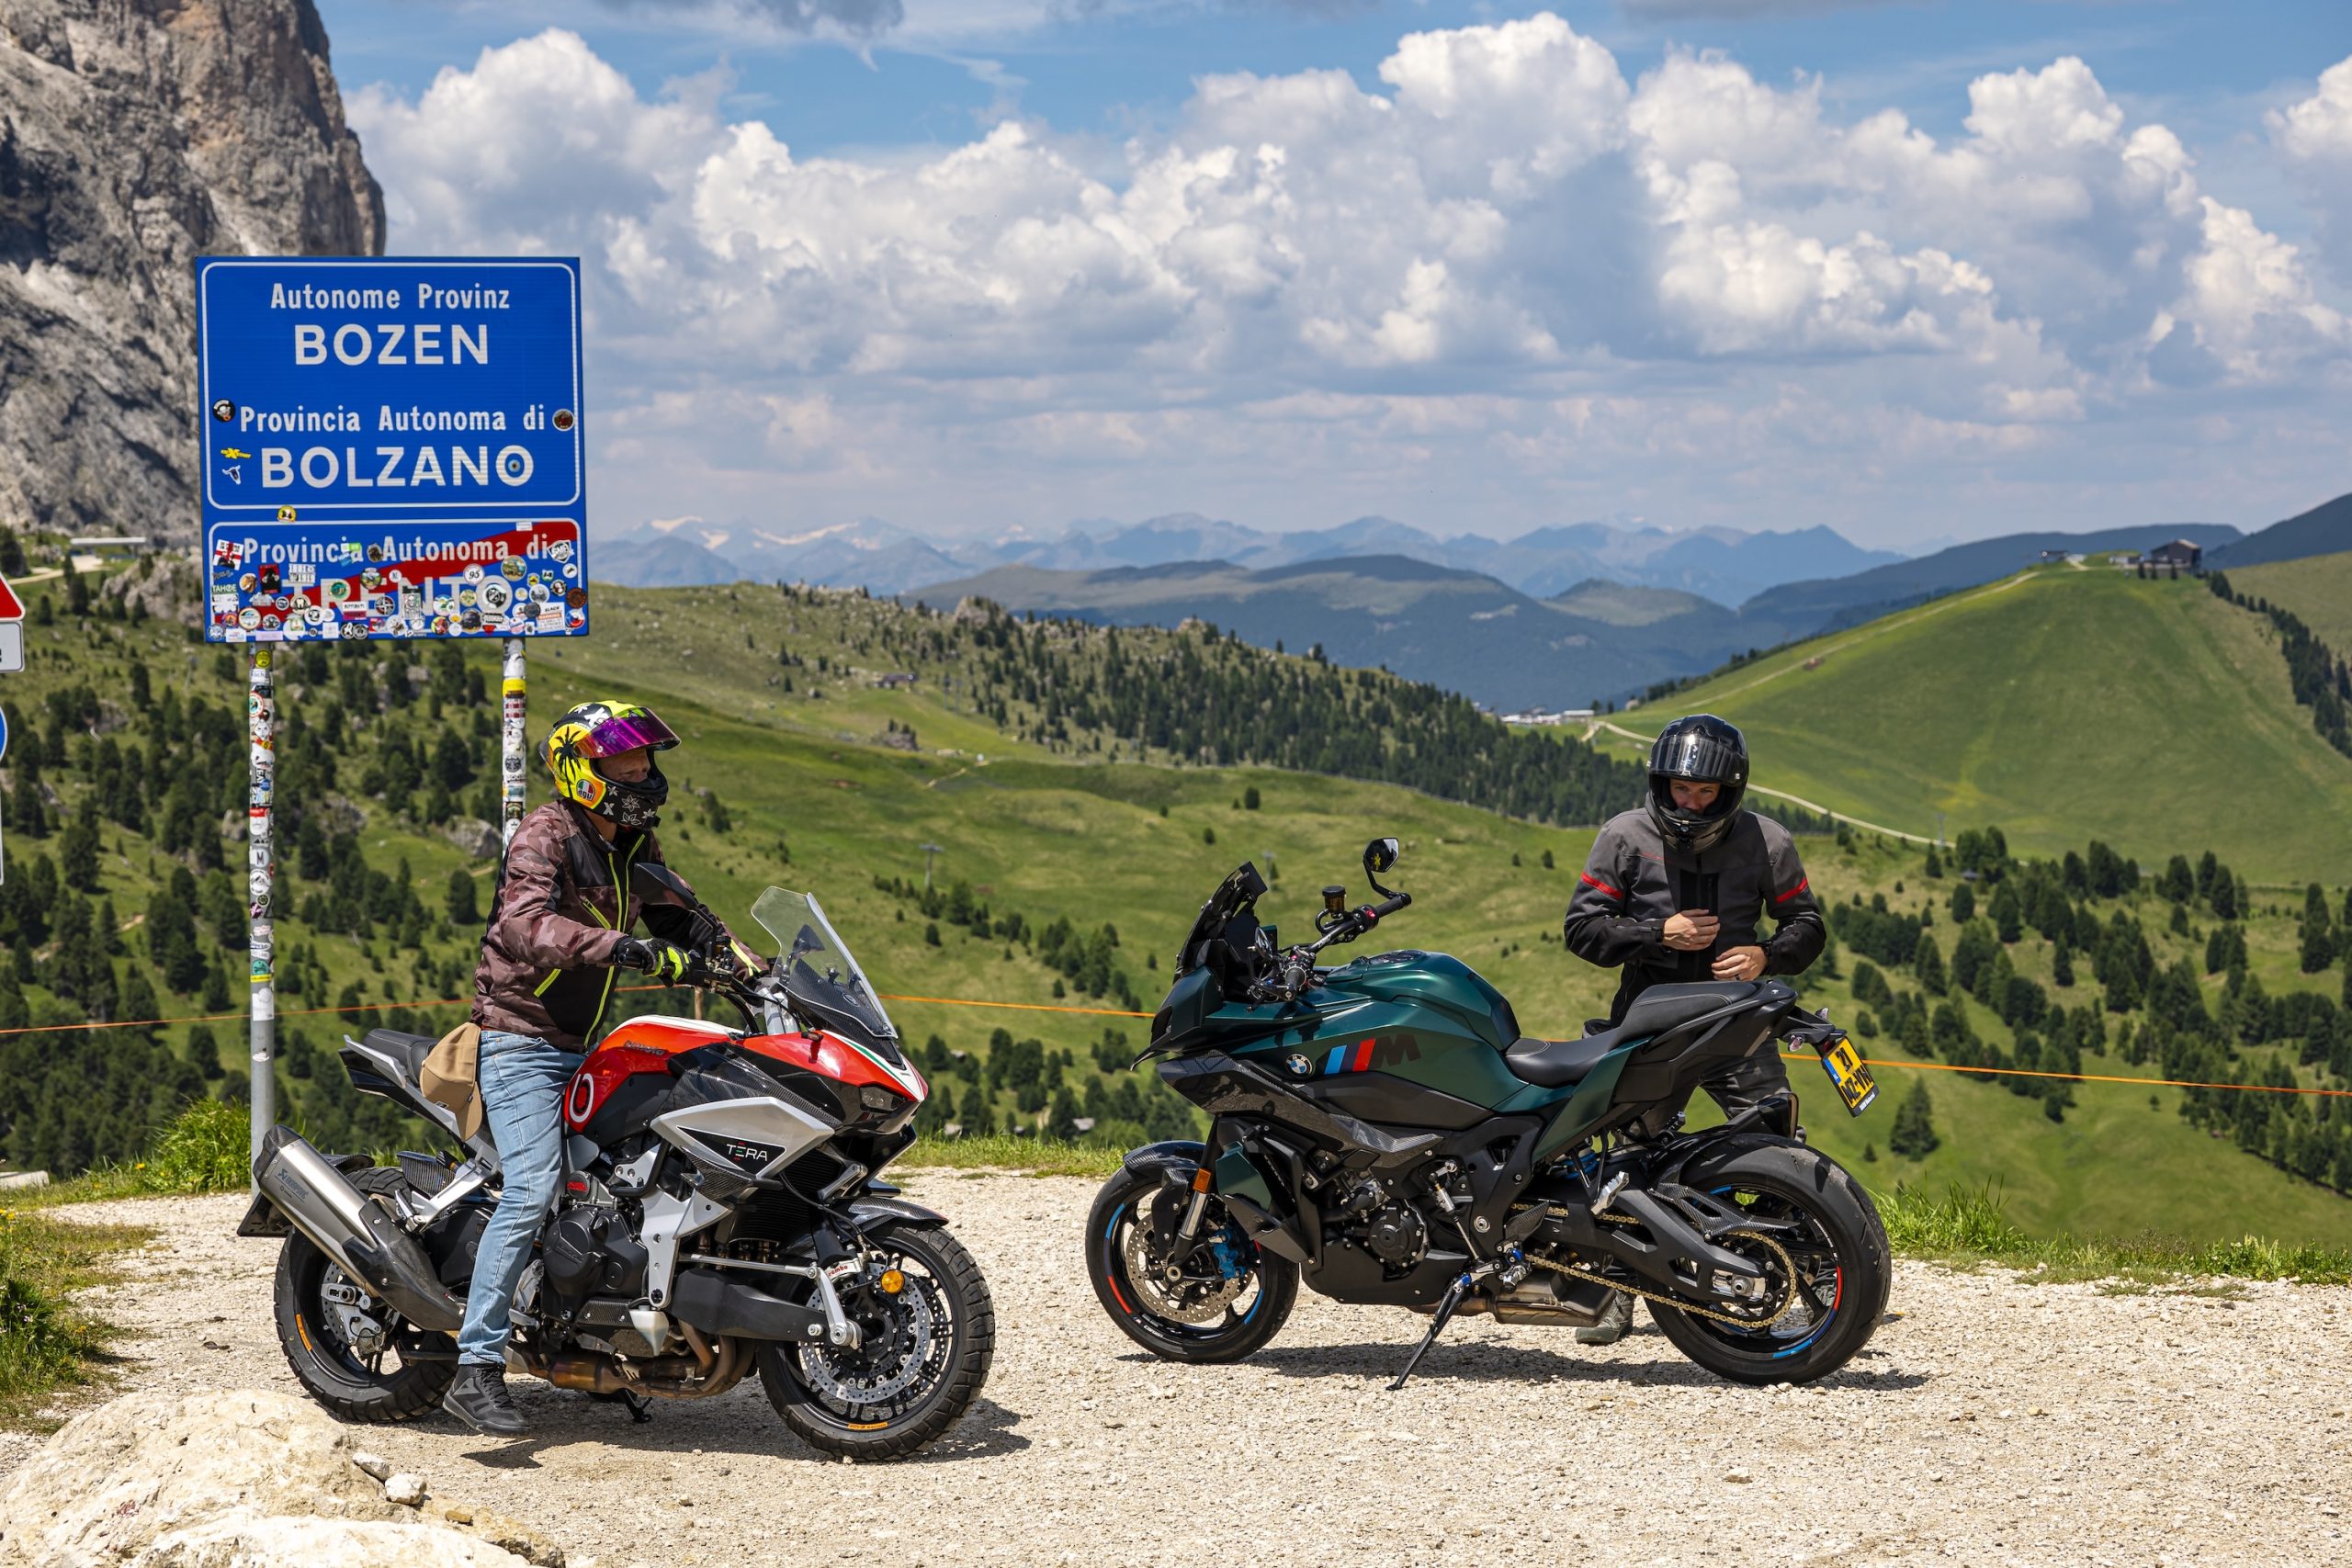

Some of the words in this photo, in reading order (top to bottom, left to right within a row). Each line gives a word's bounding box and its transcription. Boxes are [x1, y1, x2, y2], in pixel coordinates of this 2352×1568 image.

[270, 282, 401, 309] Autonome
[418, 282, 510, 310] Provinz
[294, 323, 489, 366] BOZEN
[240, 404, 361, 432] Provincia
[379, 404, 506, 431] Autonoma
[523, 404, 545, 430] di
[261, 445, 534, 488] BOLZANO
[381, 536, 509, 561] Autonoma
[526, 534, 548, 559] di
[469, 570, 480, 580] 95
[1836, 1047, 1853, 1073] 21
[726, 1143, 768, 1162] TERA
[828, 1265, 848, 1277] rembo
